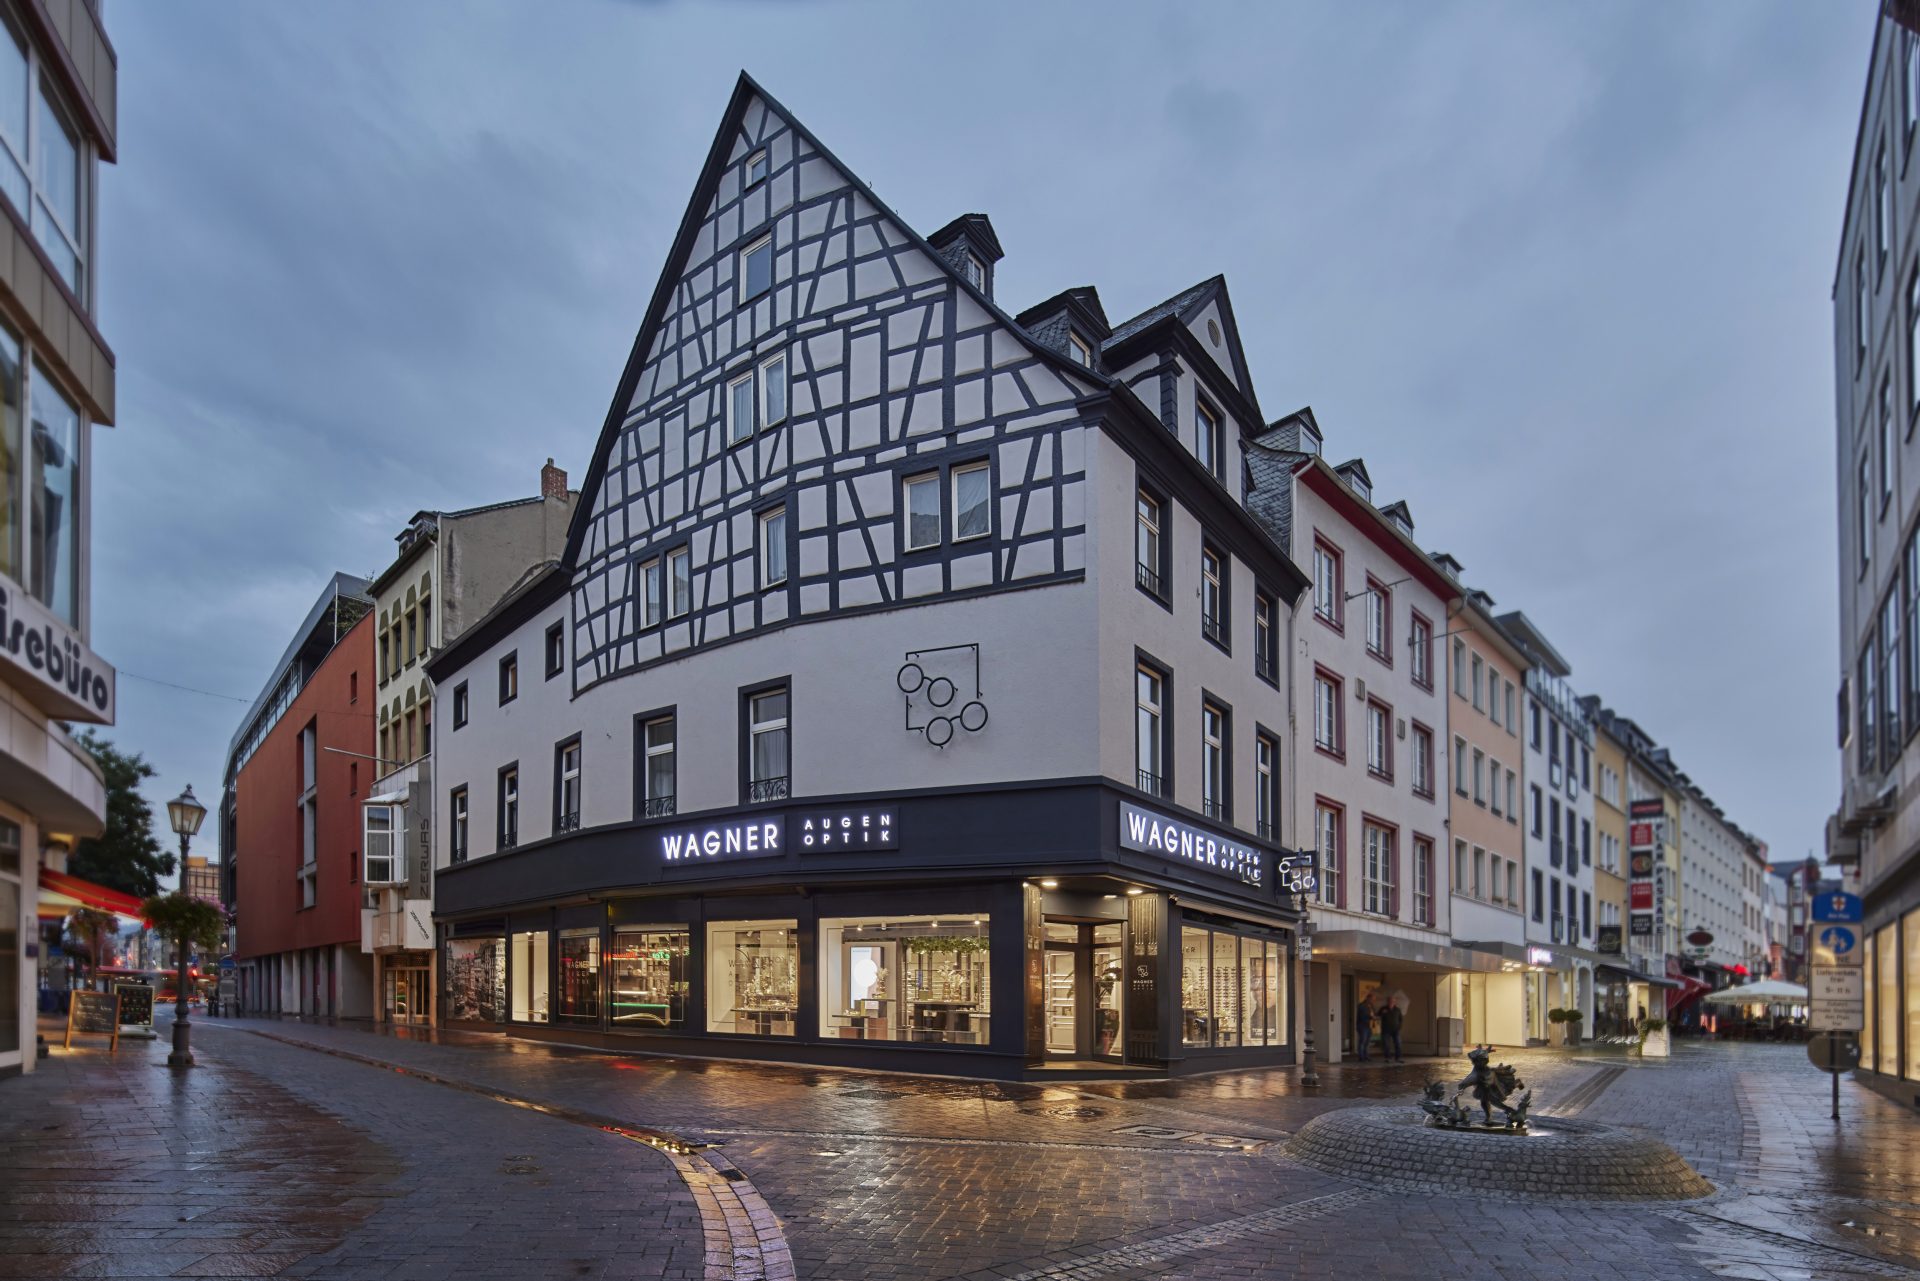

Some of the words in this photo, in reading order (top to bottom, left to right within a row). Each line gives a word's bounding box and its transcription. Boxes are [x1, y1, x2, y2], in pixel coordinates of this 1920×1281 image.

[804, 814, 891, 831] AUGEN
[662, 824, 779, 860] WAGNER
[803, 830, 890, 846] OPTIK
[1128, 812, 1216, 867] WAGNER
[420, 818, 430, 899] ZERWAS
[1220, 845, 1259, 866] AUGEN
